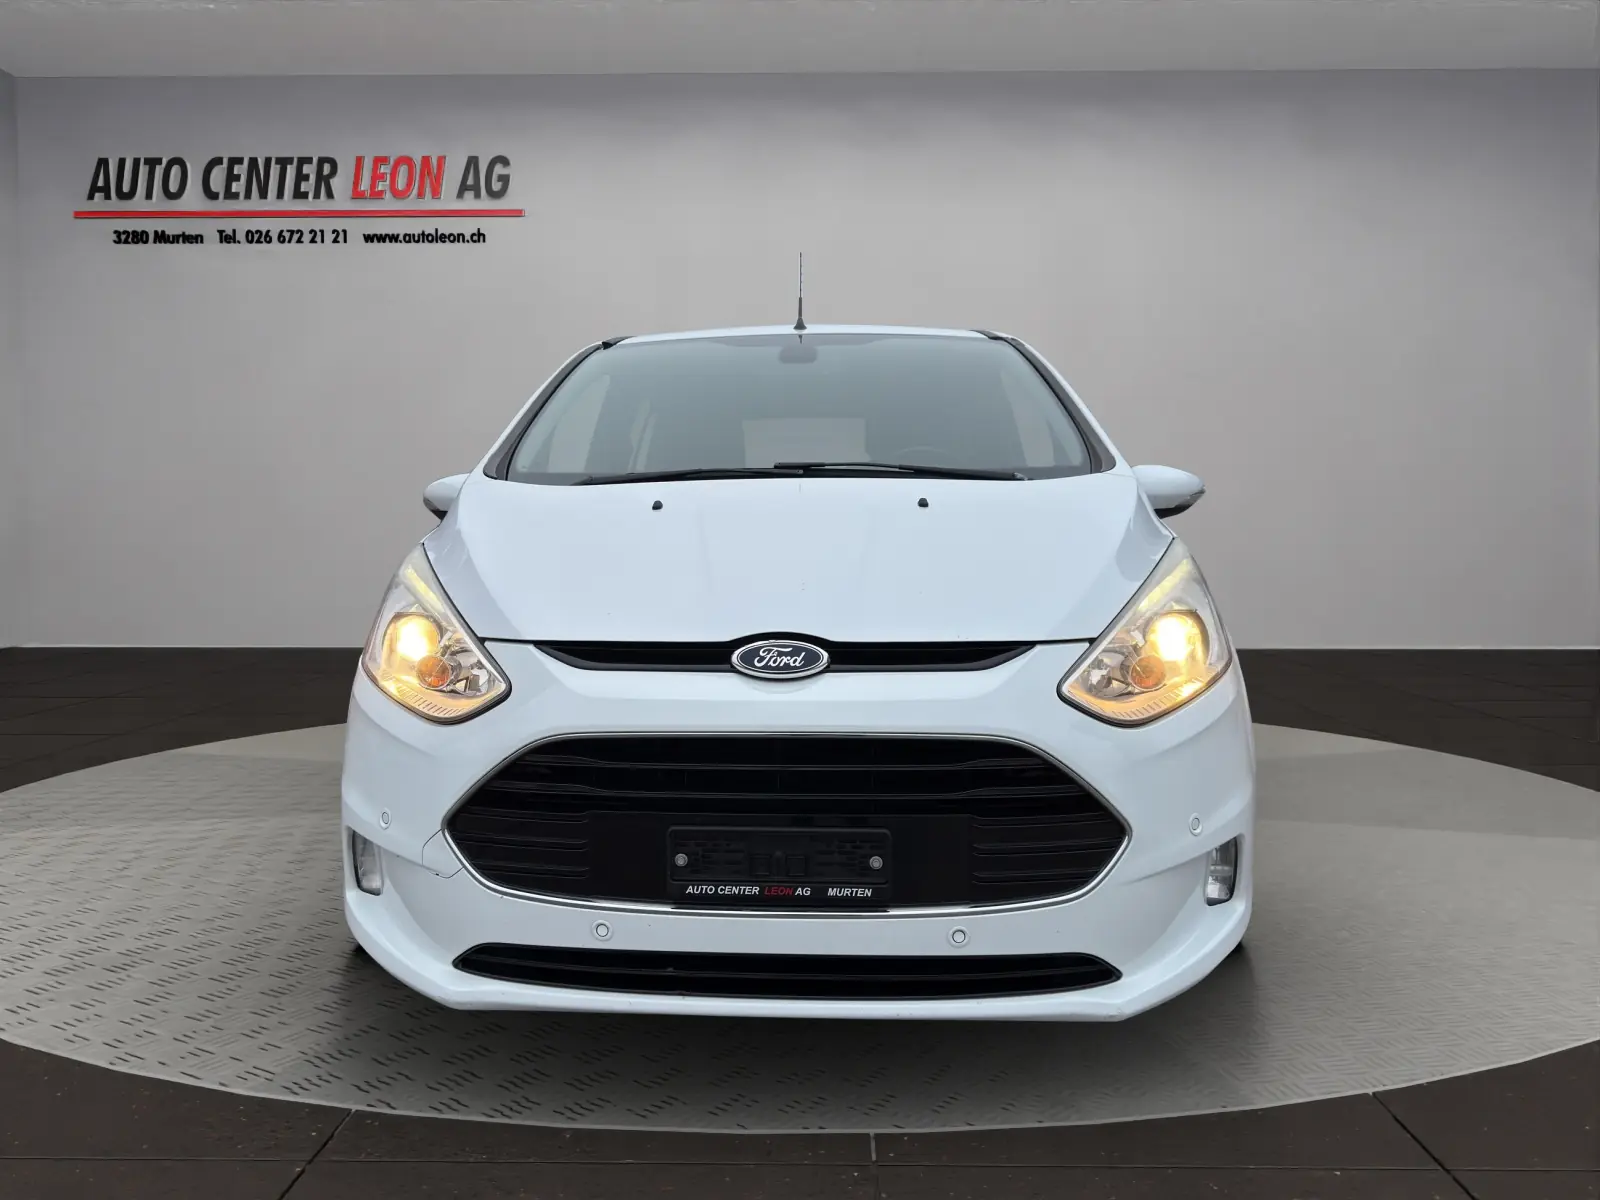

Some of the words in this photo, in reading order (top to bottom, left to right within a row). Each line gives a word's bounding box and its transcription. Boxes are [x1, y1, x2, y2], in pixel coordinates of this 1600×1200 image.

[87, 156, 189, 201] AUTO
[201, 156, 339, 201] CENTER
[351, 155, 446, 200] LEON
[456, 155, 512, 200] AG
[112, 230, 149, 245] 3280
[152, 230, 204, 245] Murten
[217, 230, 241, 245] Tel.
[245, 230, 272, 245] 026
[277, 230, 304, 245] 672
[308, 230, 326, 244] 21
[331, 230, 348, 244] 21
[362, 229, 486, 244] www.autoleon.ch
[754, 646, 806, 667] Ford
[686, 886, 715, 895] AUTO
[717, 886, 760, 896] CENTER
[764, 886, 793, 896] LEON
[795, 887, 811, 897] AG
[827, 888, 872, 898] MURTEN
